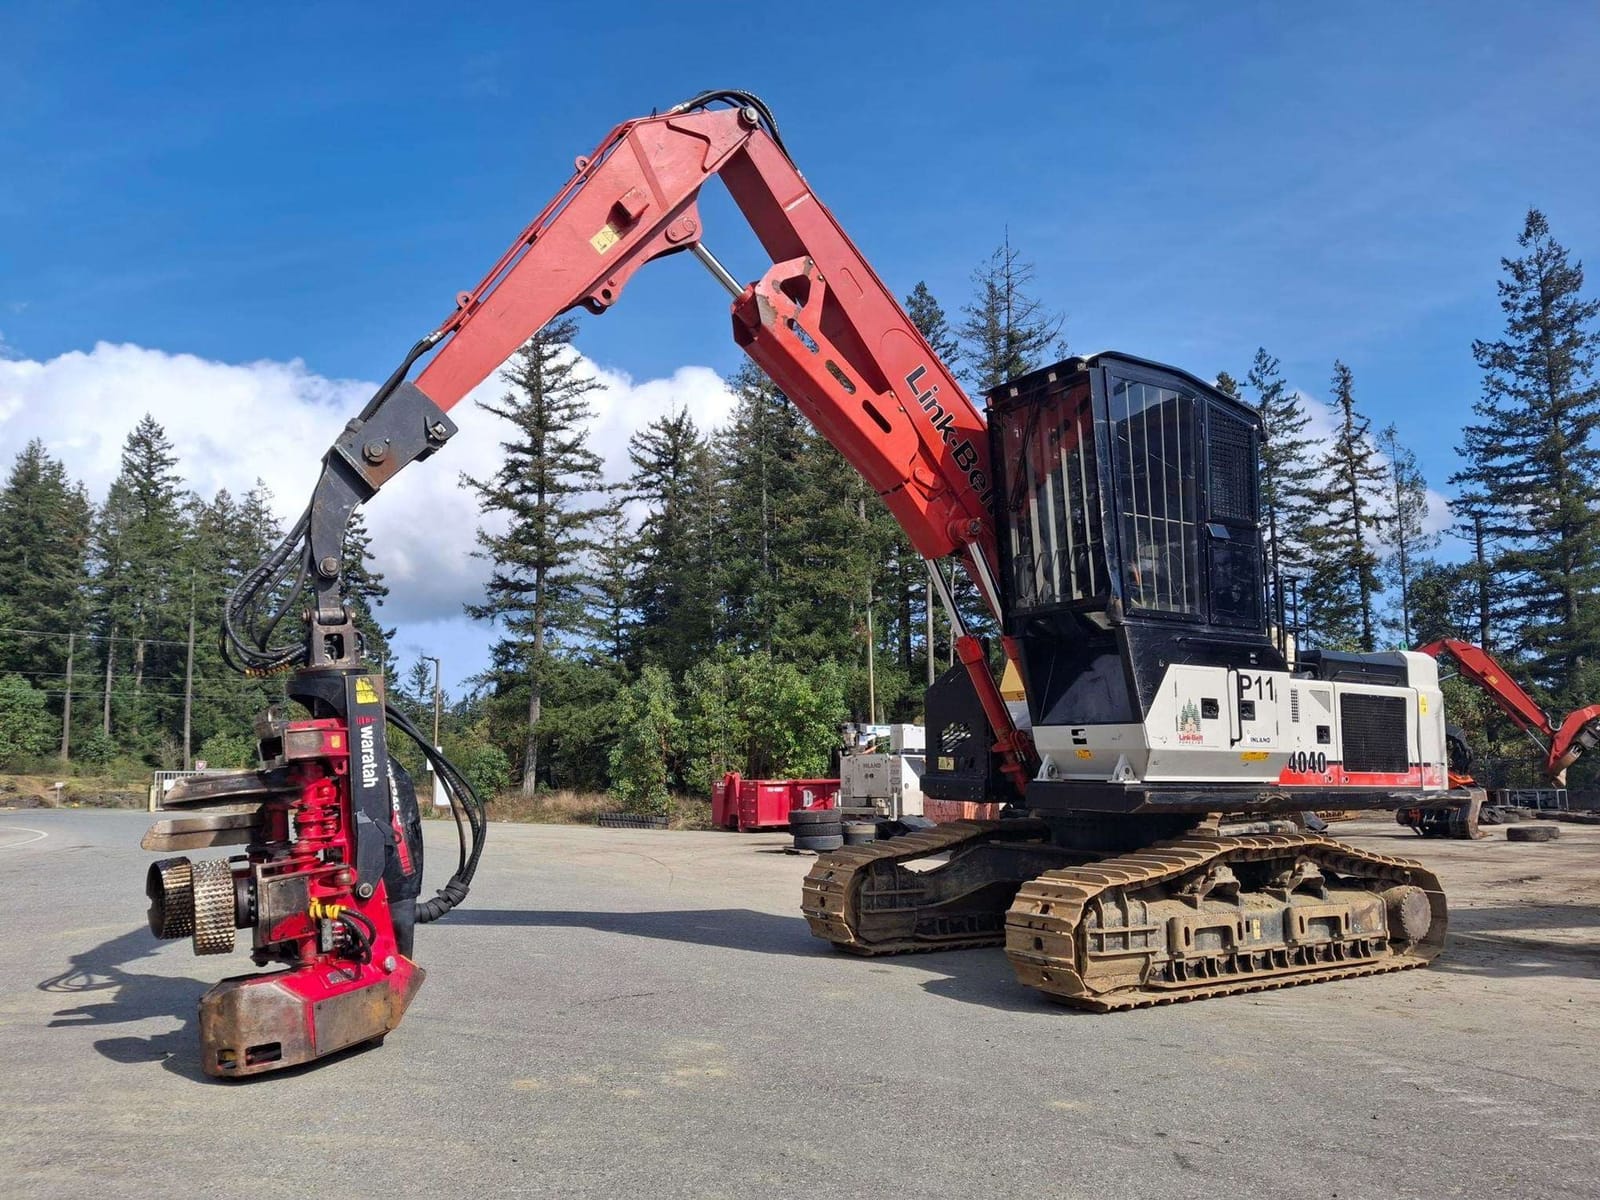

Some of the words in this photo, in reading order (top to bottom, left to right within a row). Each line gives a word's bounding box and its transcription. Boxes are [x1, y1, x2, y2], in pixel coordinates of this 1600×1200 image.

[1240, 674, 1274, 701] P11
[360, 725, 378, 788] waratah
[1288, 751, 1327, 774] 4040
